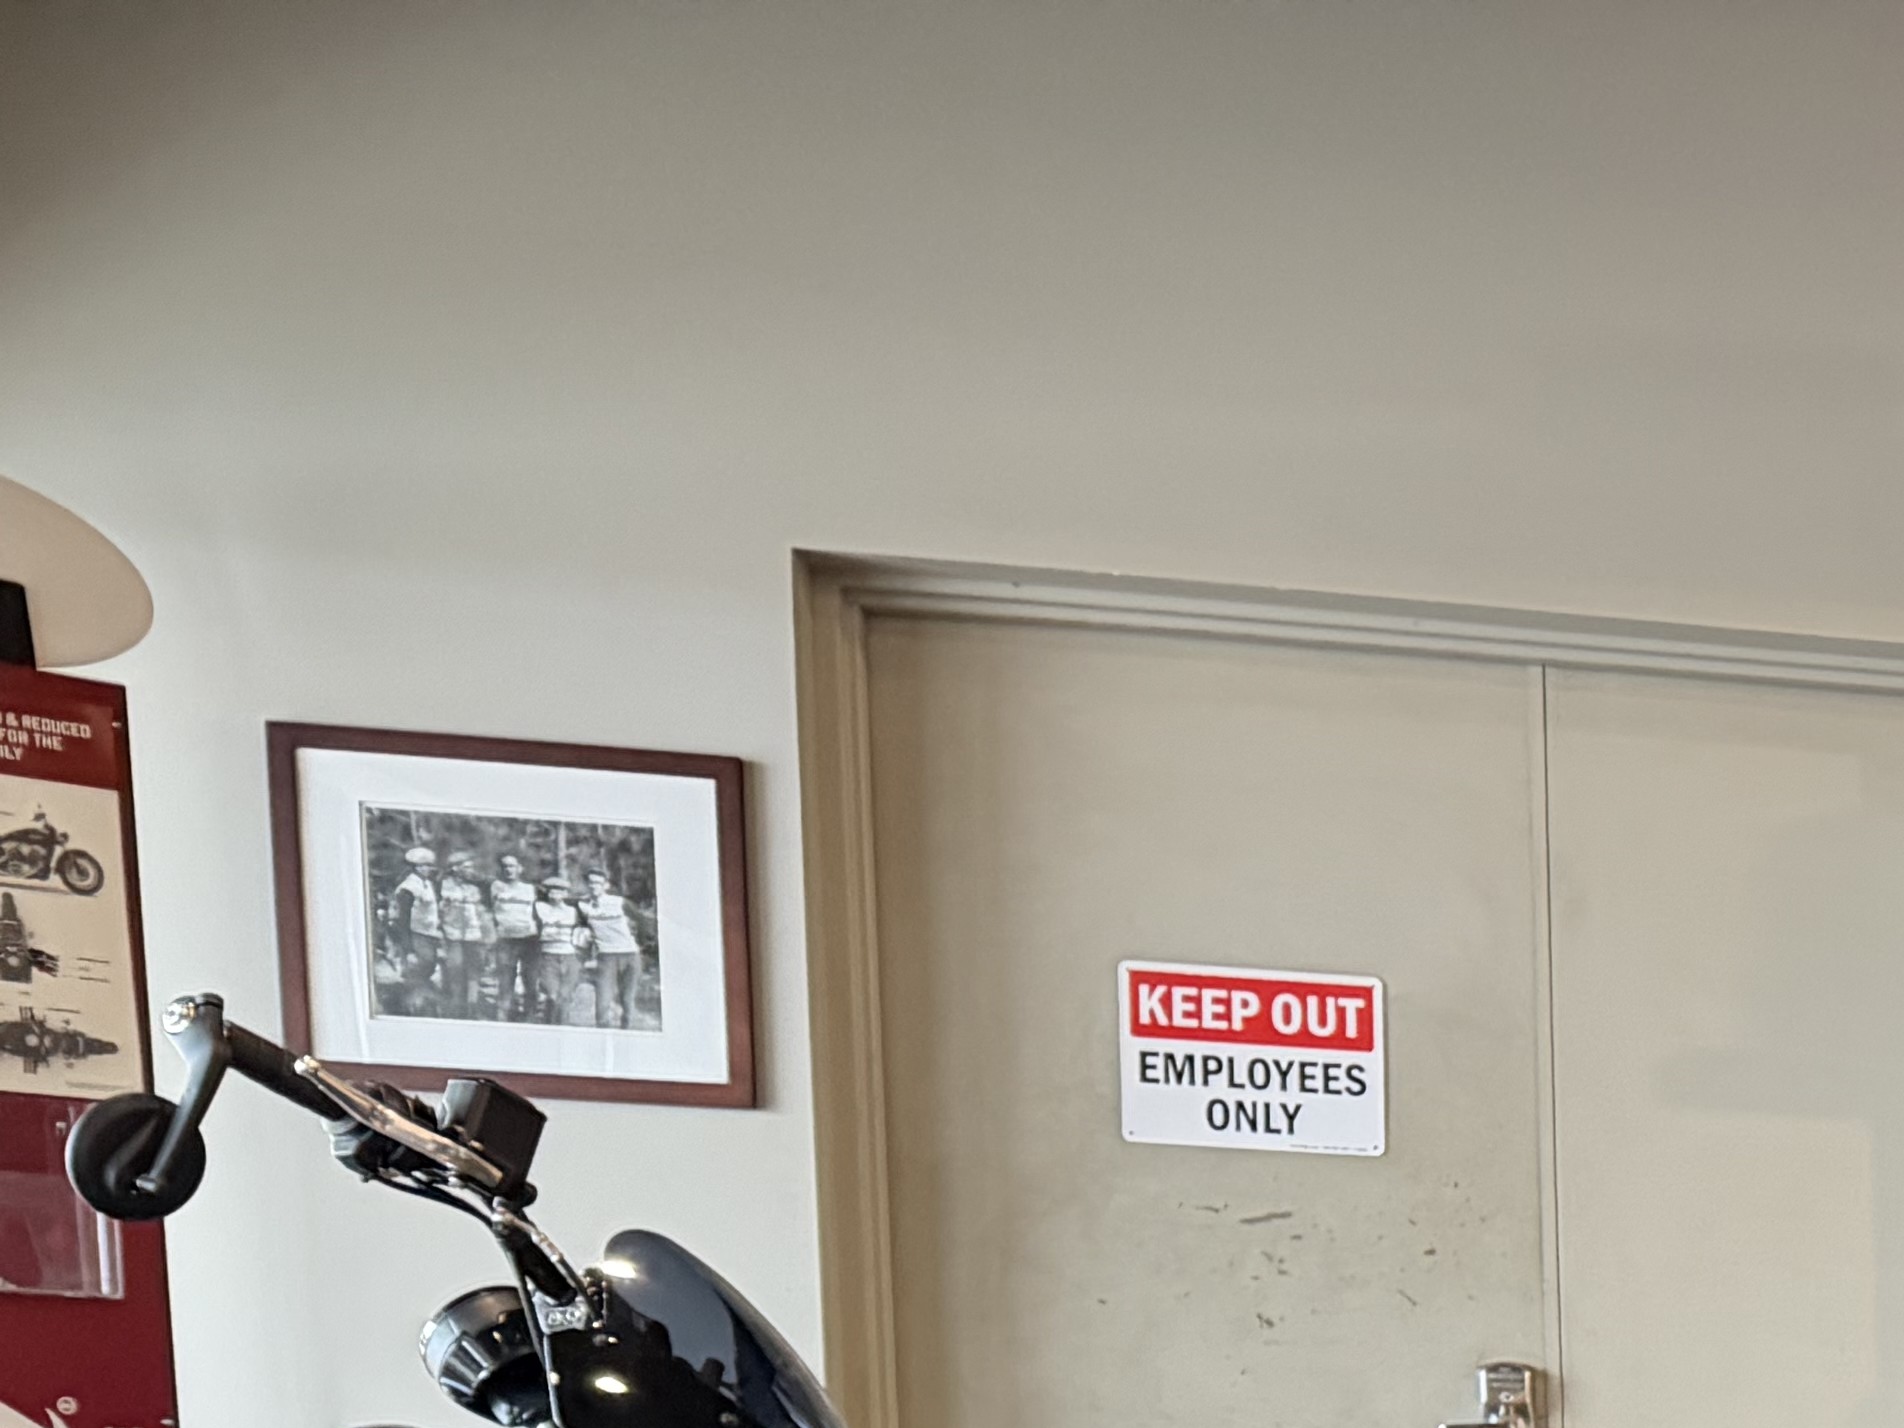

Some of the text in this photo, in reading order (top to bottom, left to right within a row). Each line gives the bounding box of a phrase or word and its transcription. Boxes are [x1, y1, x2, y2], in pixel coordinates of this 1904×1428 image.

[21, 714, 92, 739] REDUCED
[33, 732, 64, 751] THE
[1137, 983, 1366, 1039] KEEP OUT
[1138, 1050, 1367, 1097] EMPLOYEES
[1206, 1098, 1303, 1135] ONLY
